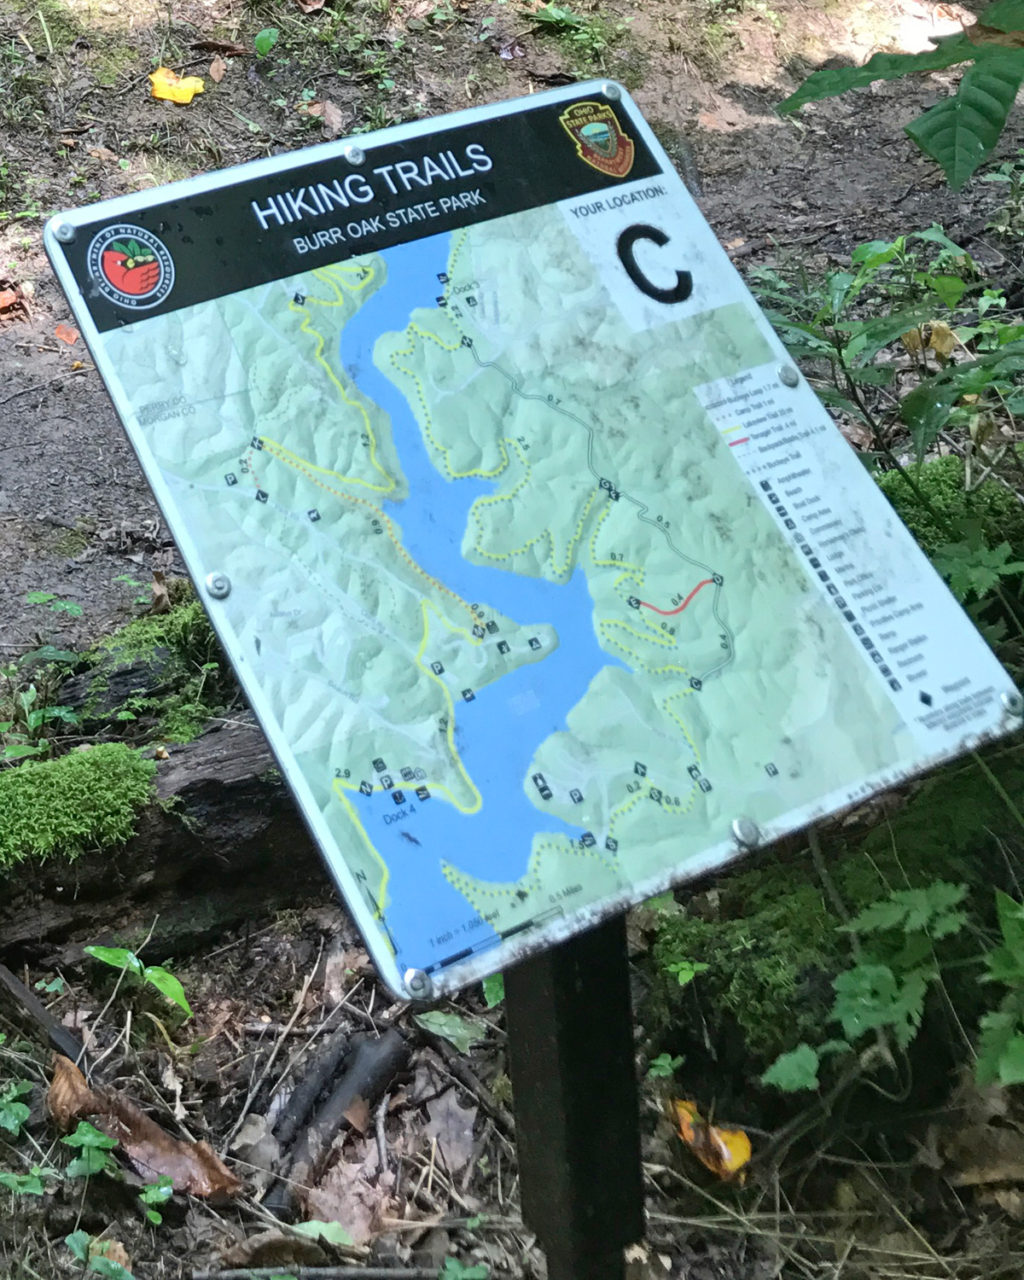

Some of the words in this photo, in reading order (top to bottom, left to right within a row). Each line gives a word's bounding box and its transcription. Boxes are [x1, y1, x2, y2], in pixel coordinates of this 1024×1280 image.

[250, 173, 375, 230] HIKING
[373, 144, 494, 198] TRAILS
[292, 226, 346, 256] BURR
[346, 215, 385, 245] OAK
[385, 202, 439, 233] STATE
[439, 188, 487, 221] PARK
[570, 198, 609, 221] YOUR
[607, 184, 669, 211] LOCATION:
[616, 223, 693, 304] C
